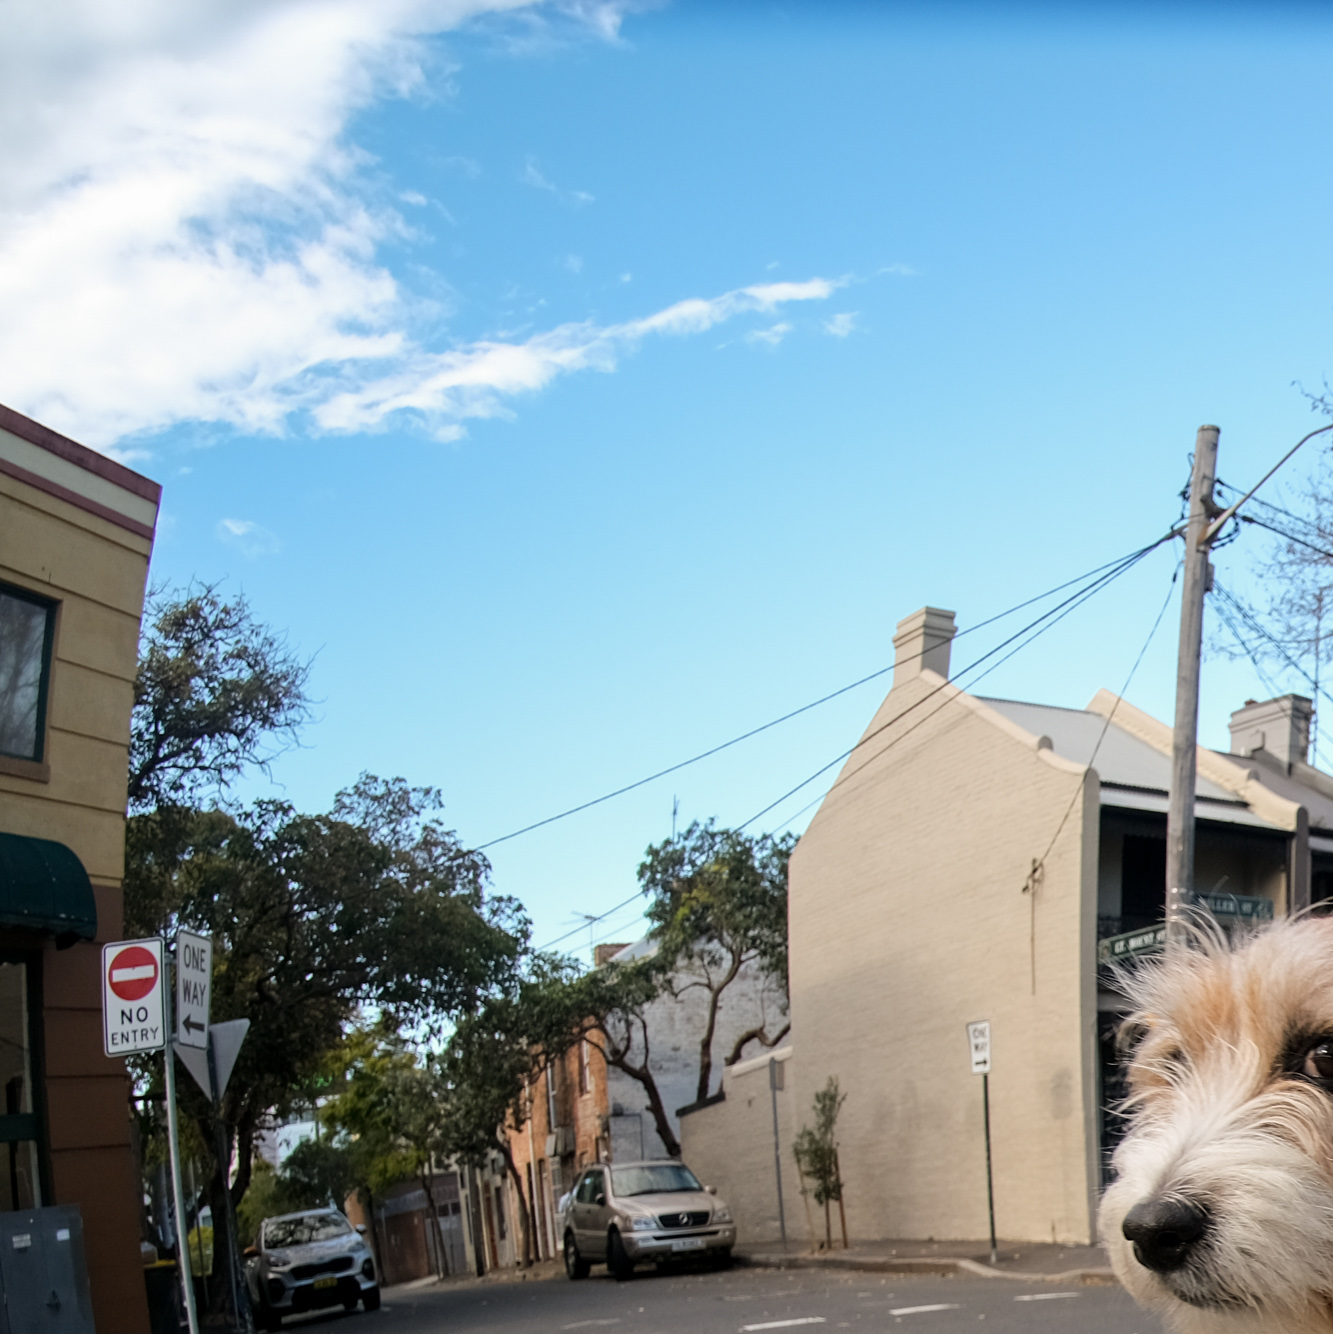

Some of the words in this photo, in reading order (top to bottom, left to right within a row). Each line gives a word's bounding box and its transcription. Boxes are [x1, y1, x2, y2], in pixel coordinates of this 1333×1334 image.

[183, 943, 207, 973] ONE
[182, 978, 207, 1007] WAY
[121, 1006, 148, 1025] NO
[111, 1026, 159, 1046] ENTRY
